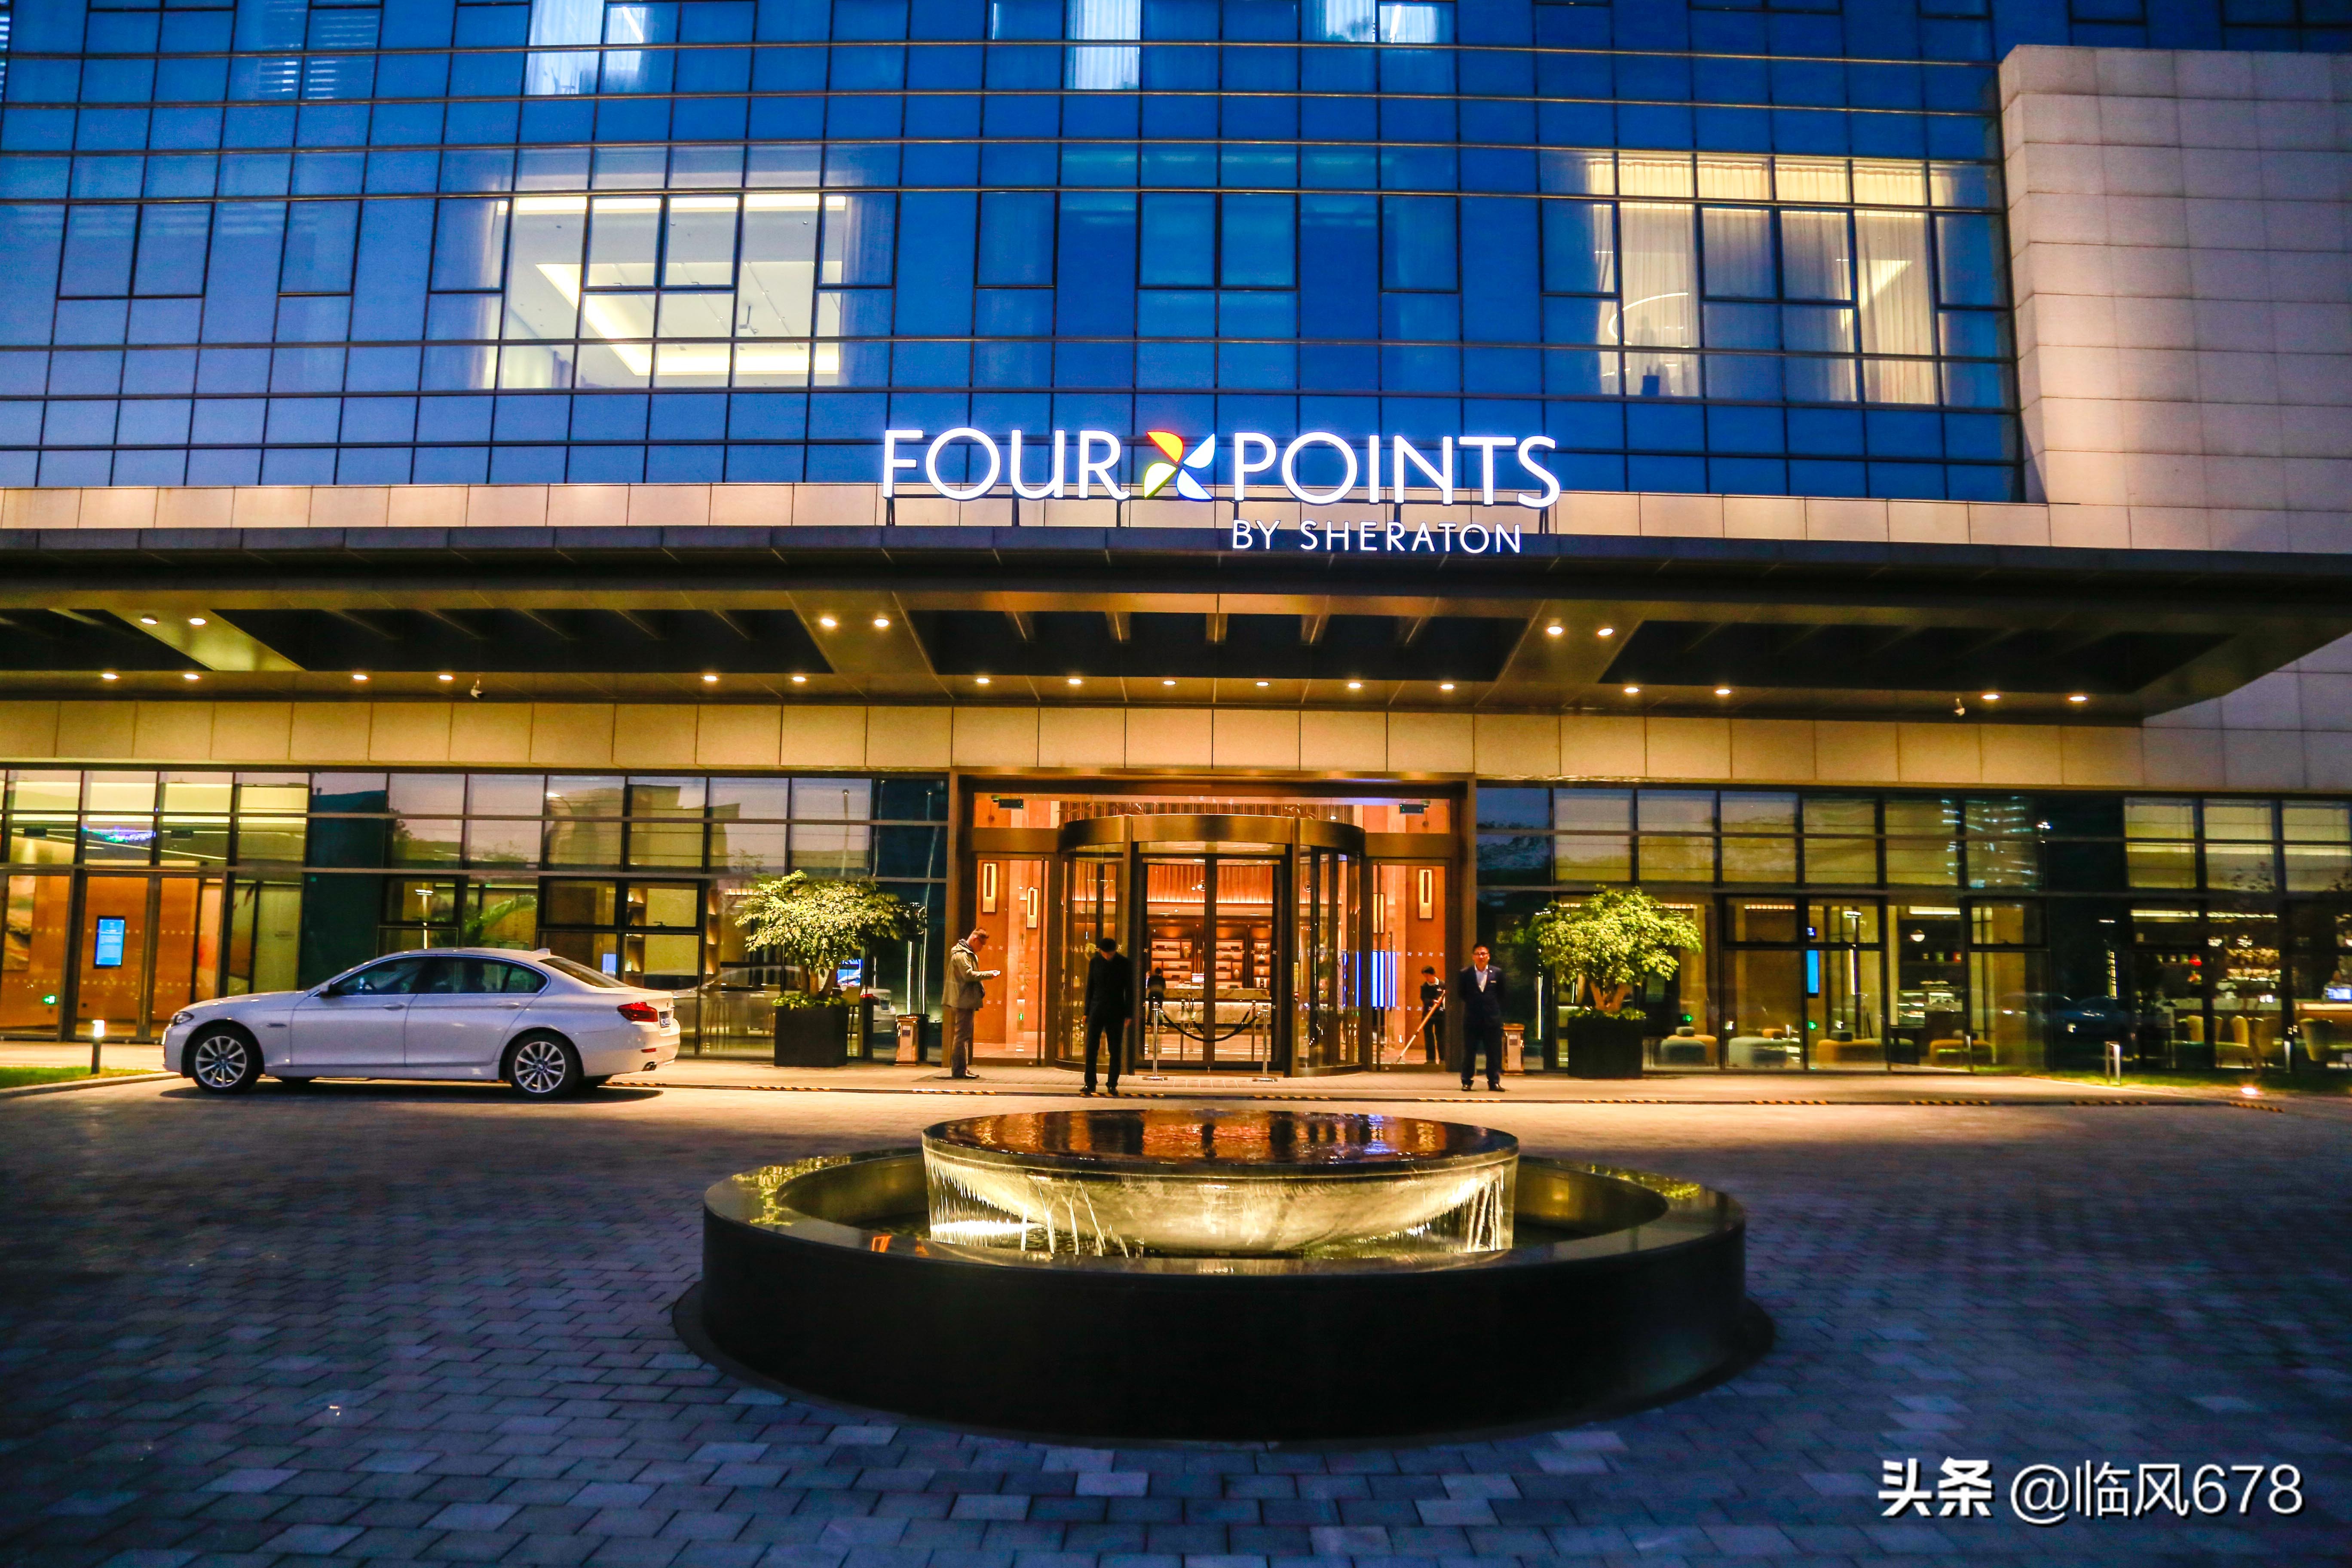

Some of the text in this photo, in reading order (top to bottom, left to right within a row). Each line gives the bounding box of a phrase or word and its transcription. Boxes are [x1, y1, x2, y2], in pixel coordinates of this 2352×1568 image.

[882, 427, 1561, 508] FOUR POINTS
[1232, 519, 1521, 554] BY SHERATON
